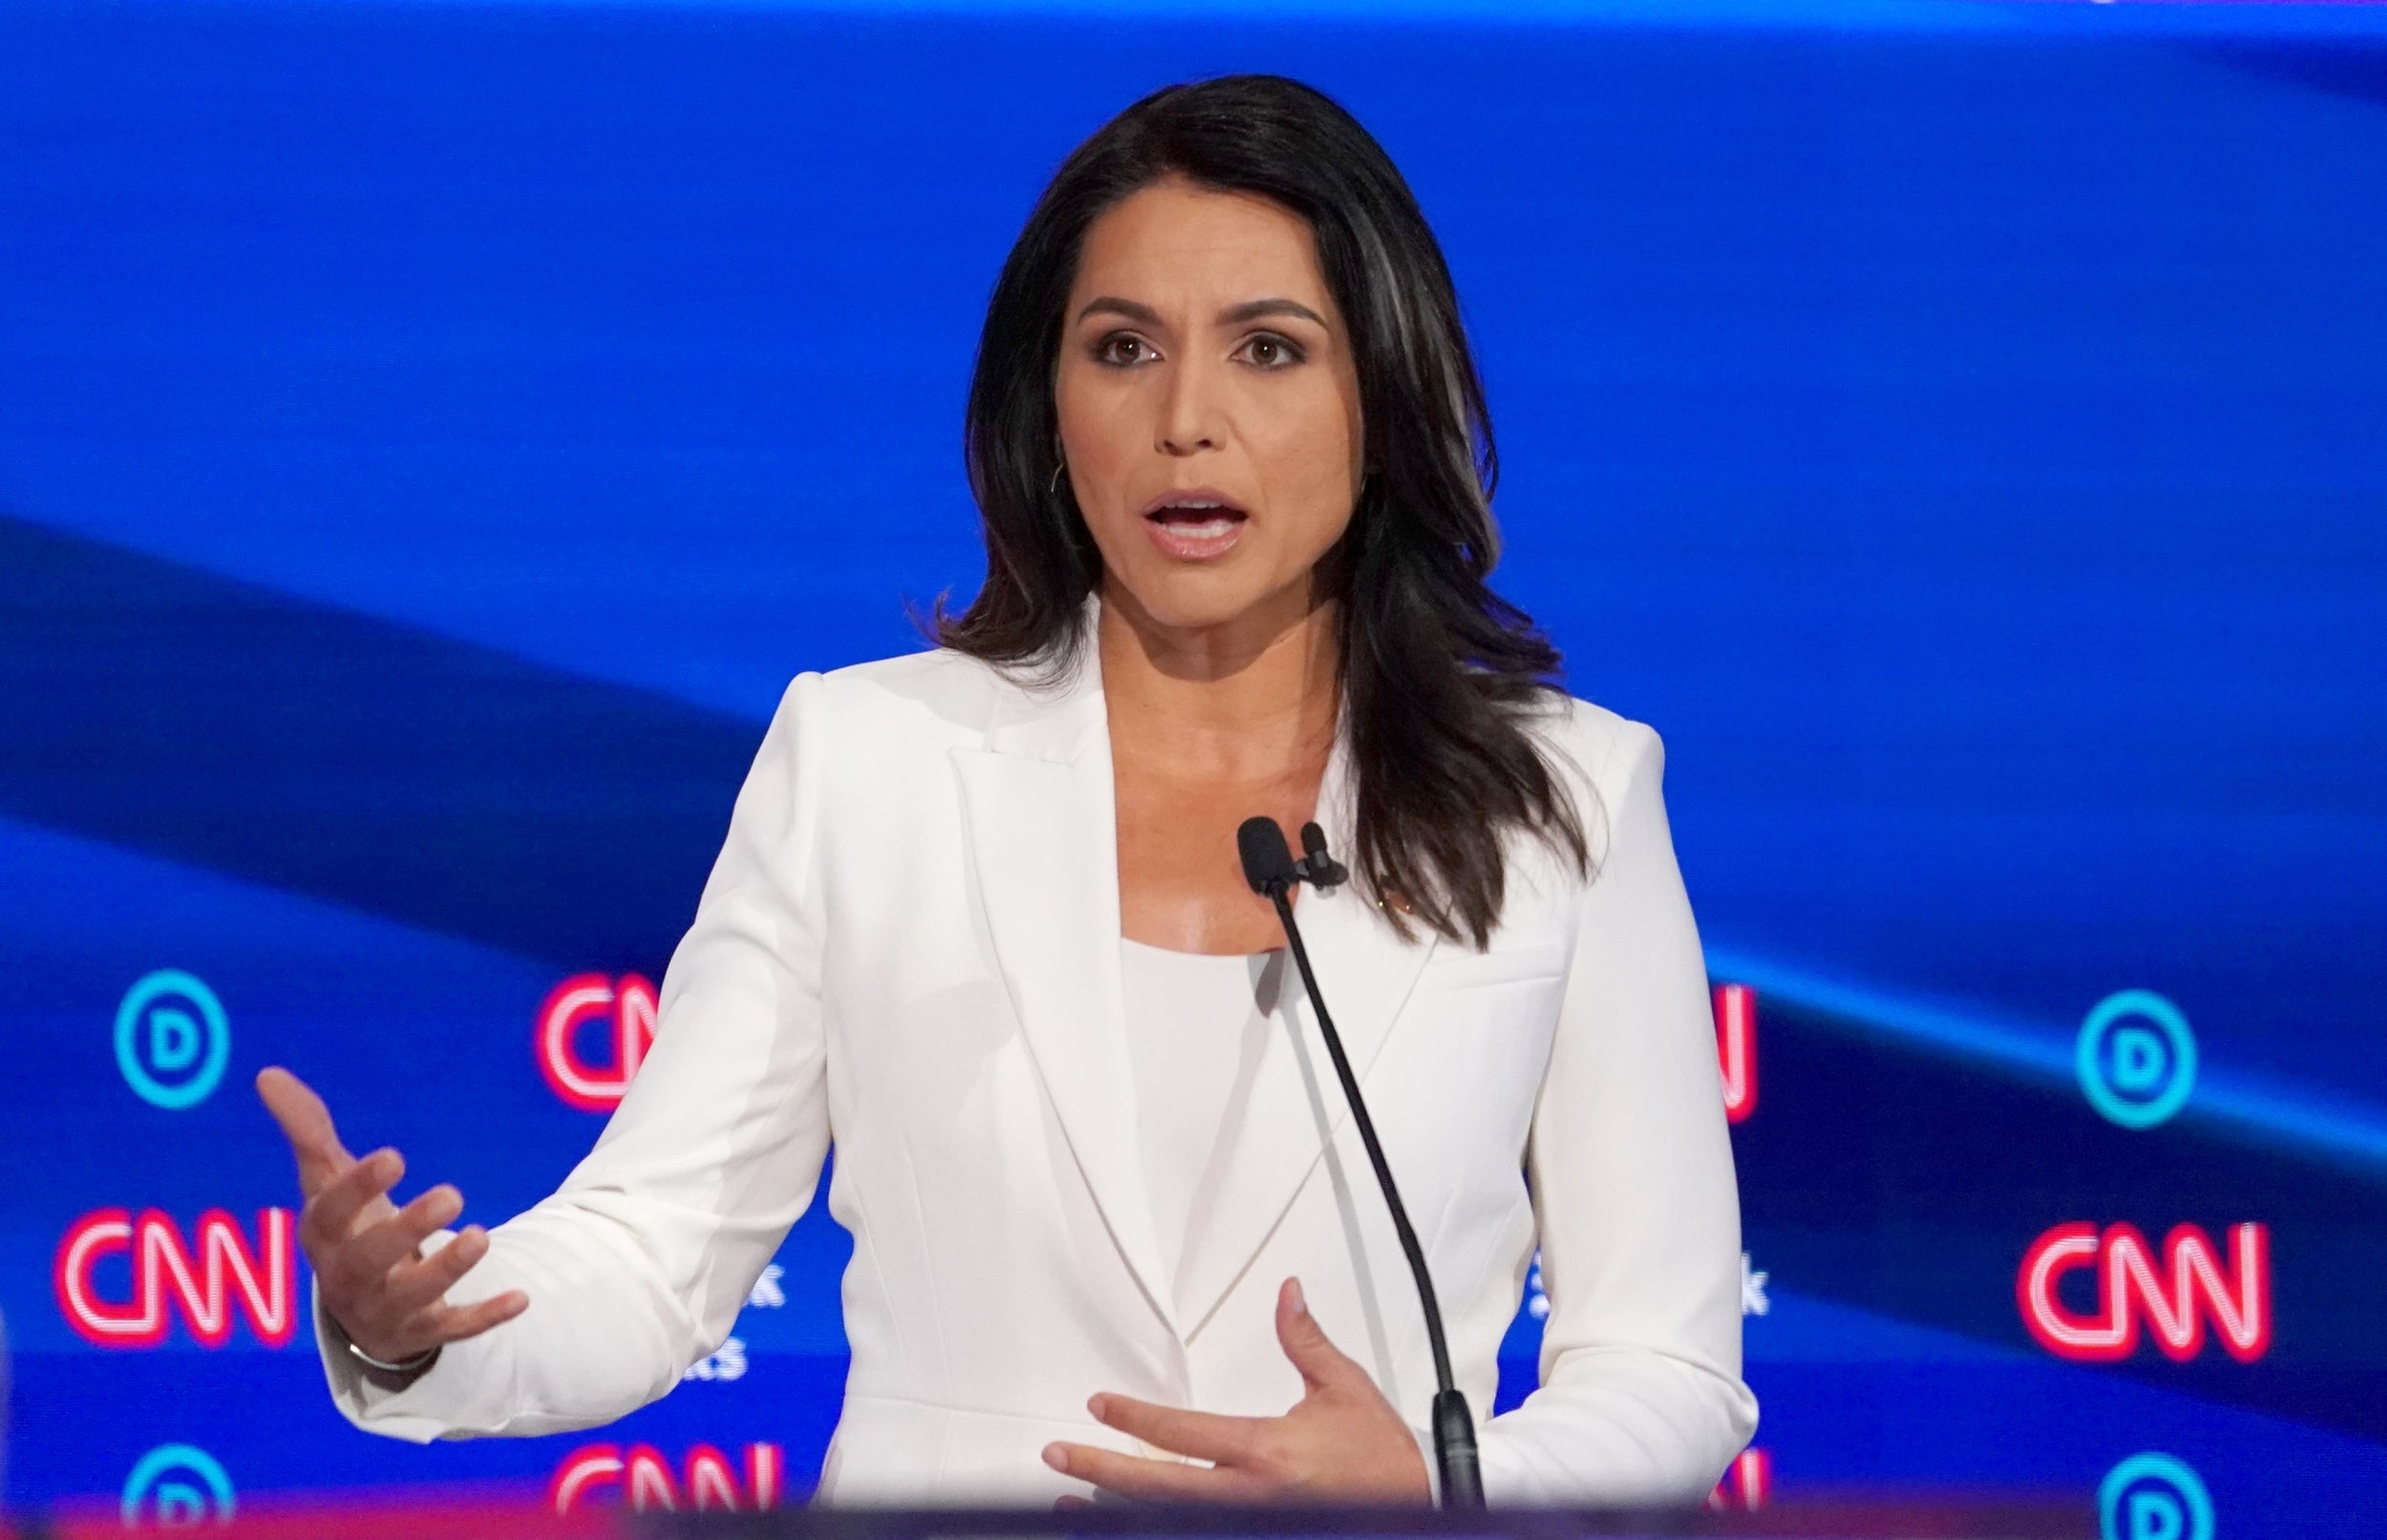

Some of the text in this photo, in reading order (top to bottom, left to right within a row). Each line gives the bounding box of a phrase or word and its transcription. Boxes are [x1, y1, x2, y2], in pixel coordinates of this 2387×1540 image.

[150, 1009, 201, 1070] D
[2114, 1028, 2165, 1089] D
[54, 1208, 296, 1349] CNN
[2017, 1221, 2271, 1362] CNN
